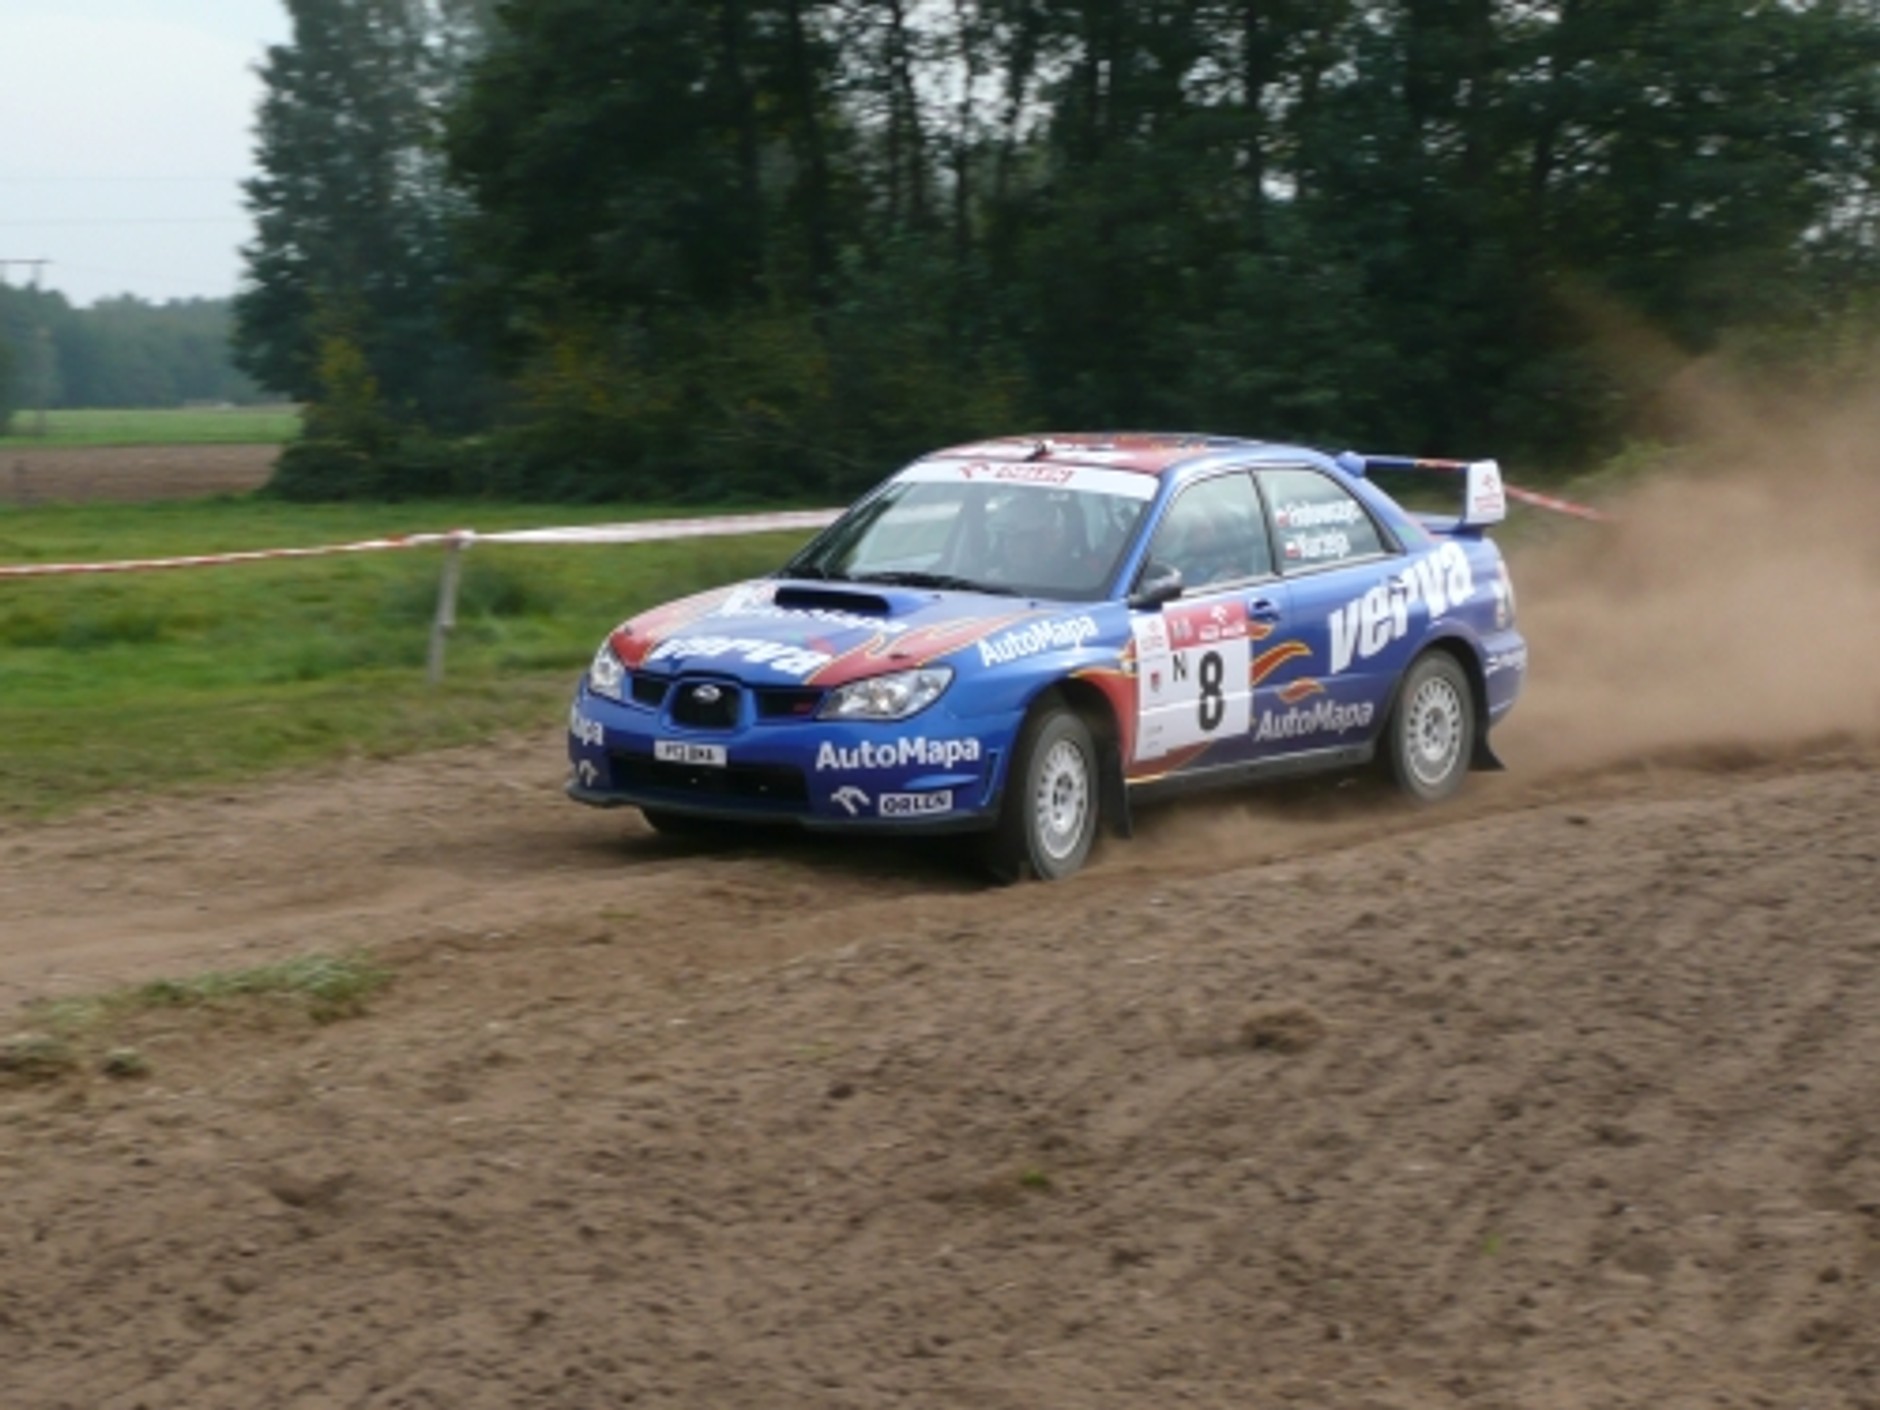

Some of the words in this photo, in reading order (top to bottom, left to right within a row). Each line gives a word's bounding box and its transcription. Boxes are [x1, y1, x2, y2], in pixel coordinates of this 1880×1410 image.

[1329, 541, 1474, 674] verva
[978, 615, 1099, 667] AutoMapa
[1173, 653, 1187, 681] N
[1199, 650, 1223, 731] 8
[1254, 699, 1374, 741] AutoMapa
[815, 736, 980, 770] AutoMapa
[883, 794, 948, 813] ORLEN
